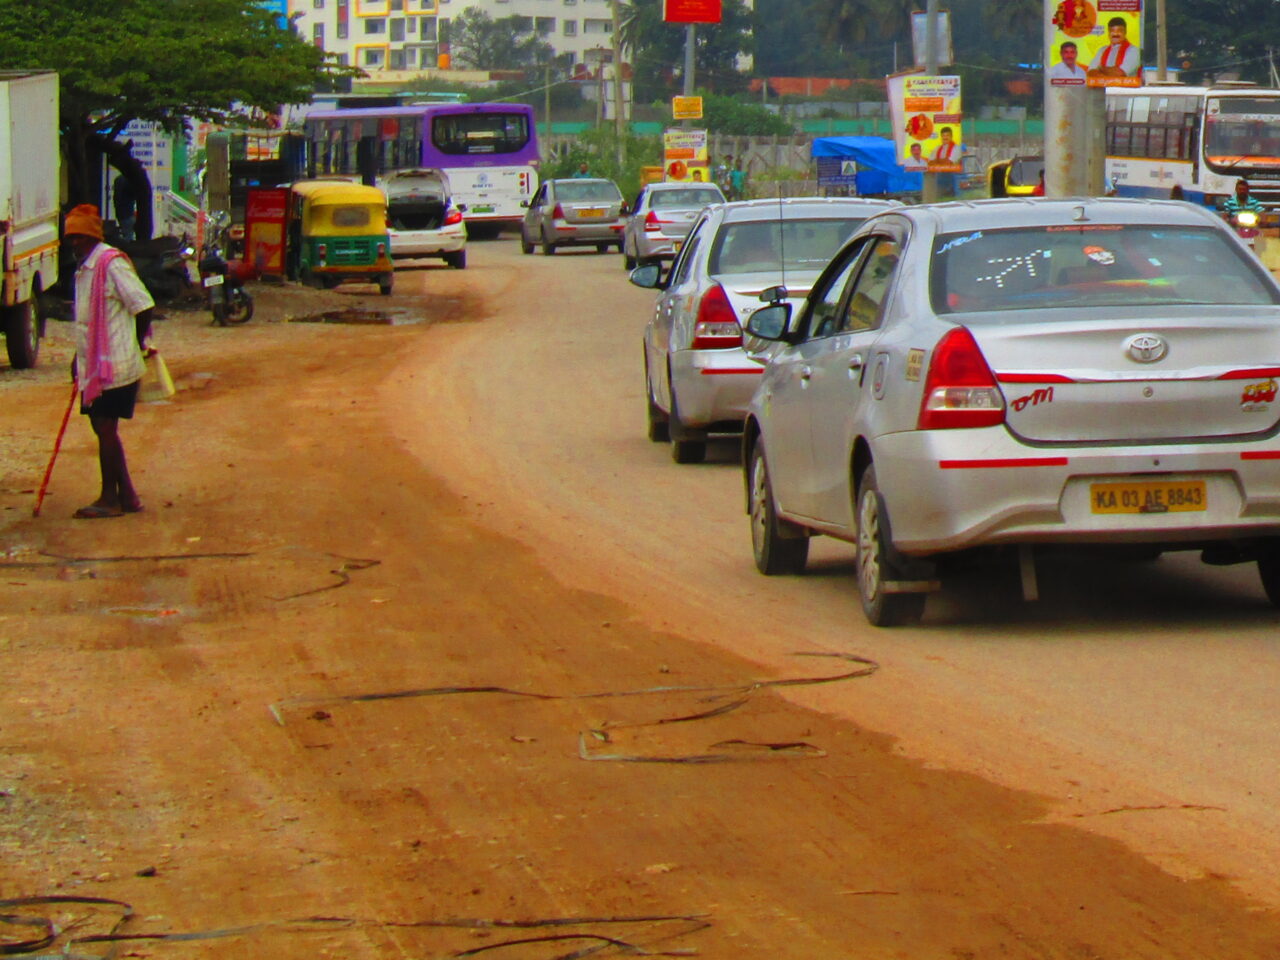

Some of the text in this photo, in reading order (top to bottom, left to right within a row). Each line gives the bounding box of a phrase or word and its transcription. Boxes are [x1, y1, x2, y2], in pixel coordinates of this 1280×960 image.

[1097, 491, 1117, 508] KA
[1122, 491, 1139, 507] 03
[1167, 489, 1202, 506] 8843
